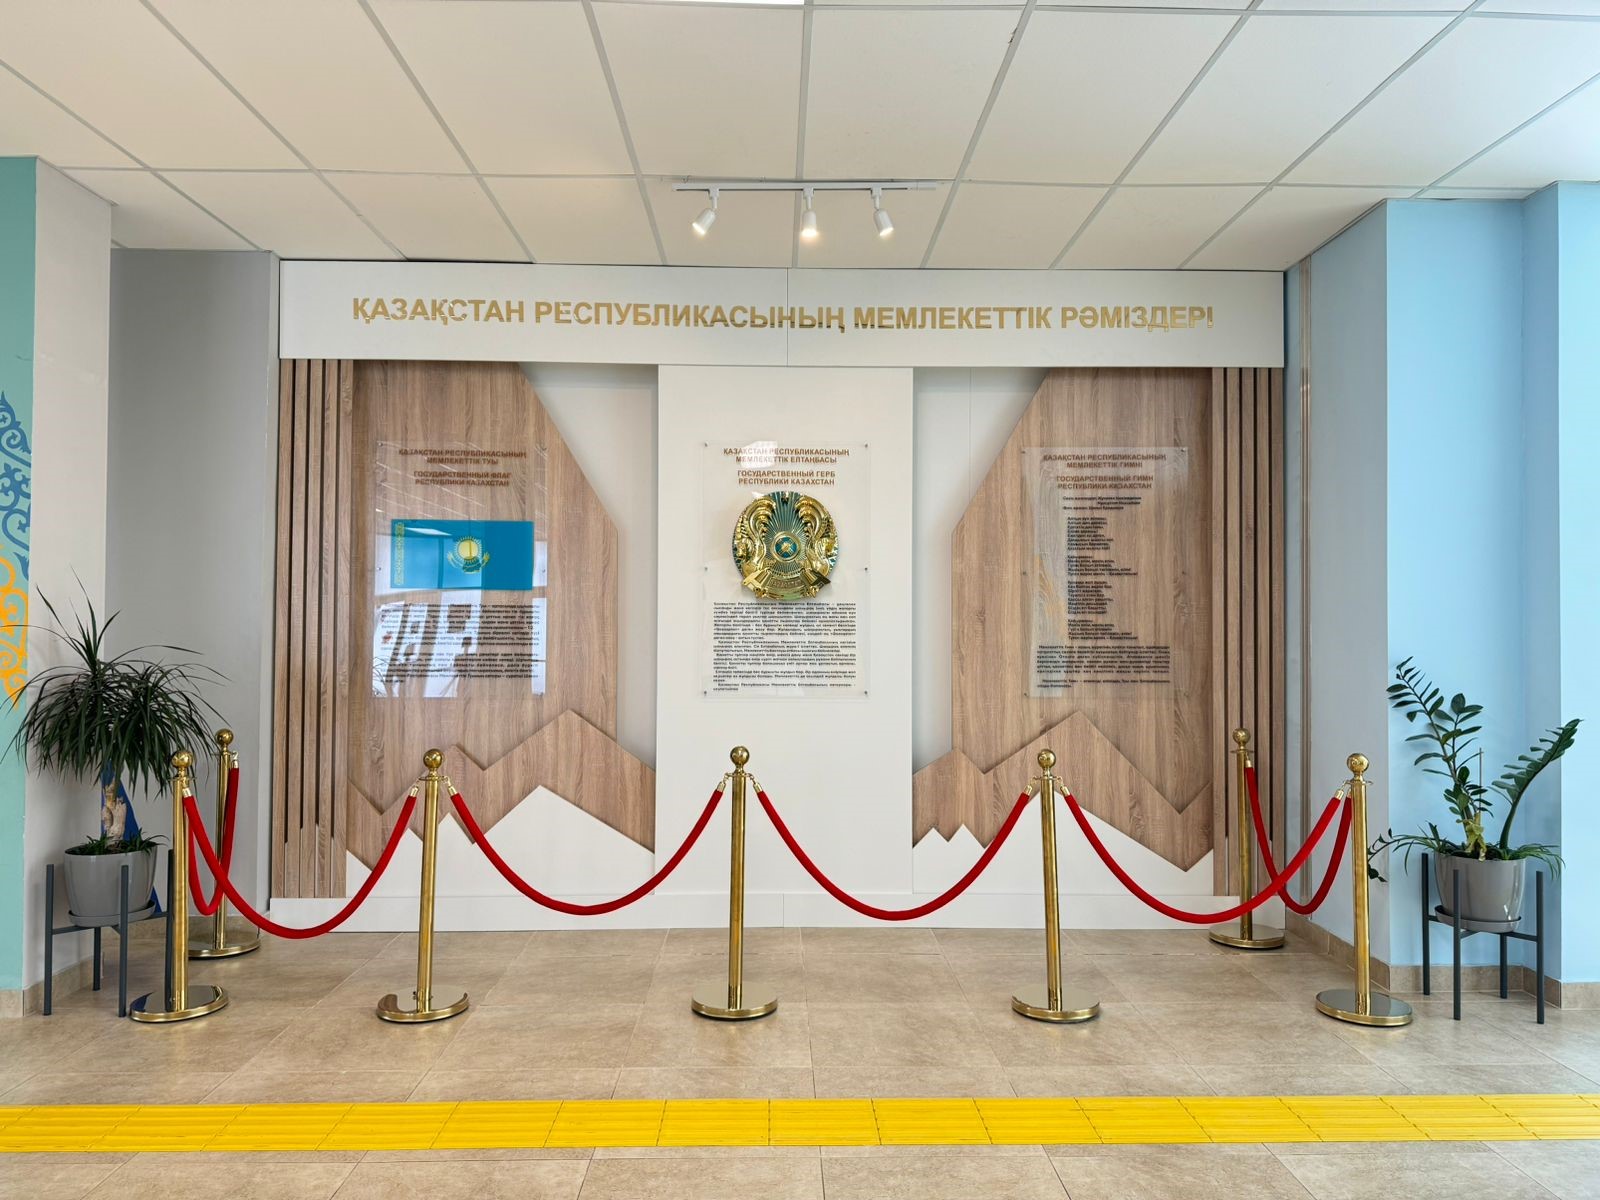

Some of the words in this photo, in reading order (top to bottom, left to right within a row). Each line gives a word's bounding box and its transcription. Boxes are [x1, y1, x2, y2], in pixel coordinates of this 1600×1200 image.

[353, 297, 525, 325] ҚАЗАҚСТАН
[535, 301, 846, 333] РЕСПУБЛИКАСЫНЫҢ
[854, 306, 1052, 330] МЕМЛЕКЕТТІК
[1061, 306, 1215, 333] РӘМІЗДЕРІ
[737, 469, 815, 478] ГОСУДАРСТВЕННЫЙ
[816, 470, 836, 478] ГЕРБ
[738, 478, 789, 486] РЕСПУБЛИКИ
[790, 478, 835, 486] КАЗАХСТАН
